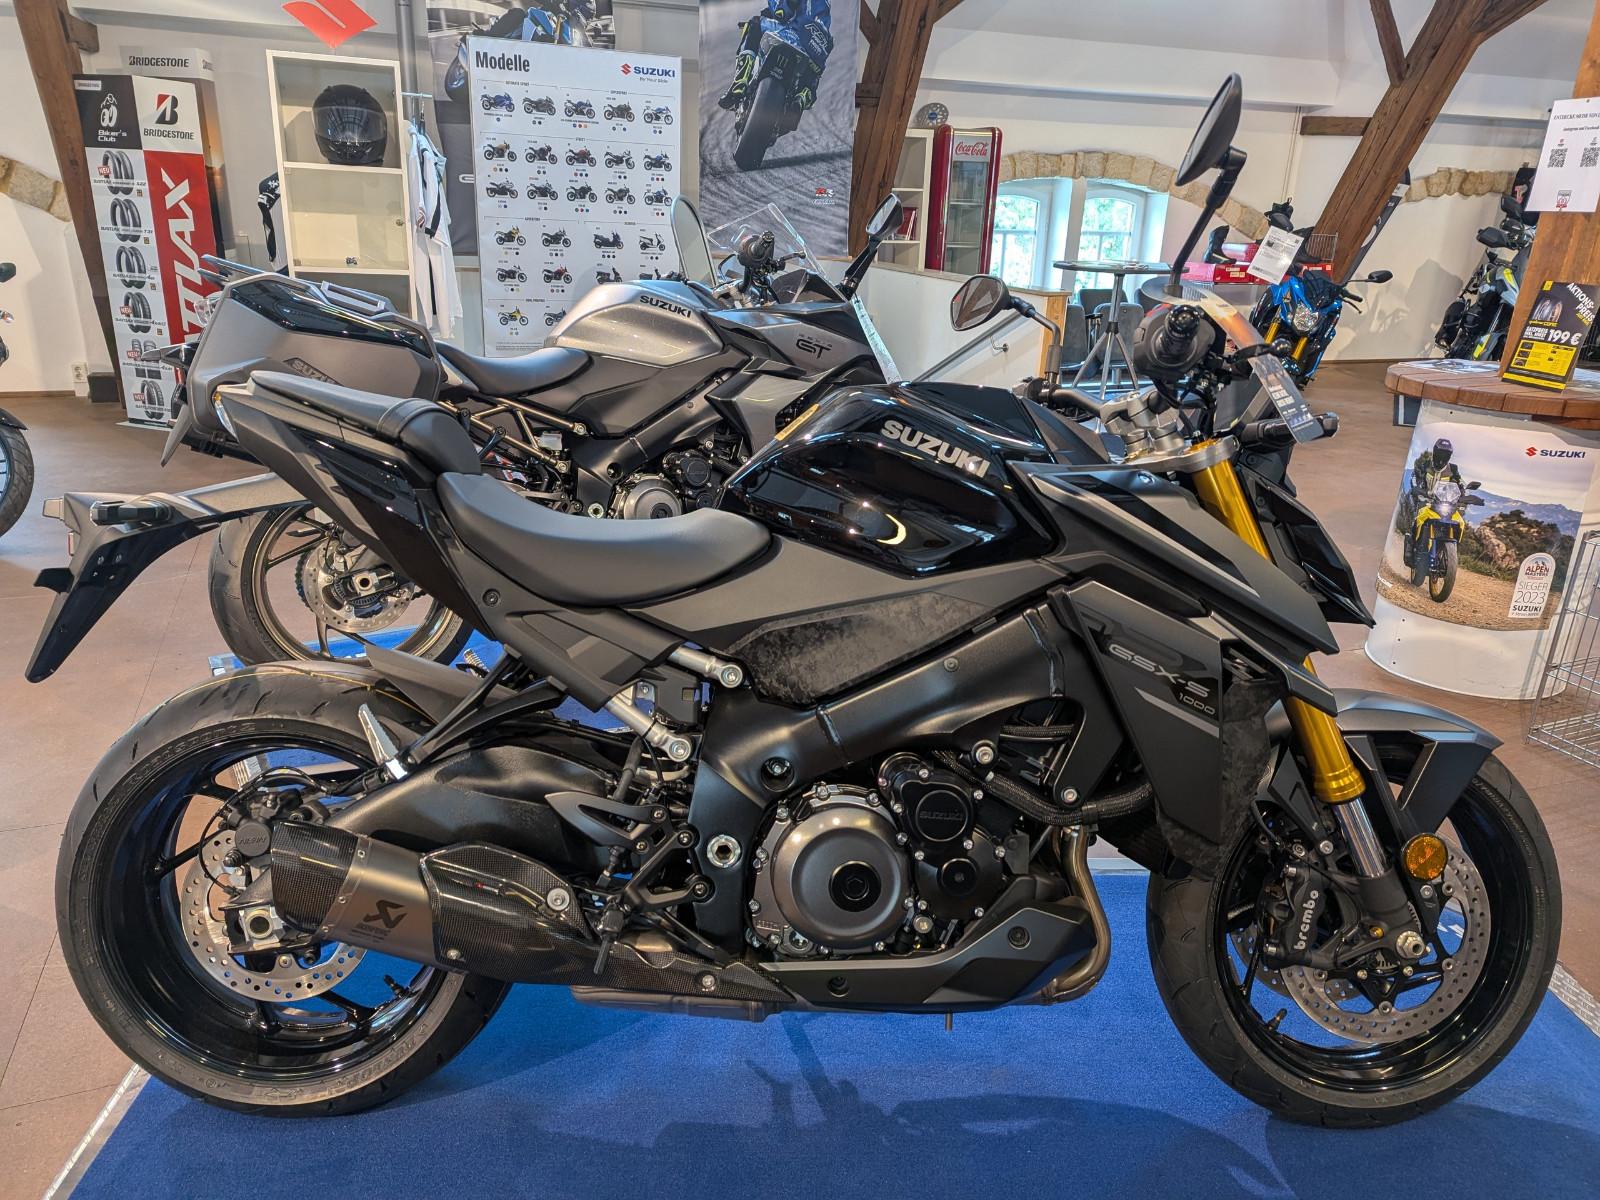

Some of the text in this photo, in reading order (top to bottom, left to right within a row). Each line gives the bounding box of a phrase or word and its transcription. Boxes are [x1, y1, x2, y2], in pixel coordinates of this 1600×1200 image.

[128, 55, 190, 68] BRIDGESTONE
[475, 50, 530, 73] Modelle
[633, 66, 676, 78] SUZUKI
[98, 129, 128, 137] Biker's
[143, 127, 195, 140] BRIDGESTONE
[1566, 282, 1595, 309] AKTIONS-
[639, 295, 692, 319] SUZUKI
[1575, 302, 1595, 322] PREIS
[1547, 328, 1583, 346] 199 €
[795, 338, 832, 360] GT
[880, 419, 991, 478] SUZUKI
[1539, 449, 1586, 459] SUZUKI
[1525, 565, 1550, 573] ALPEN
[1517, 580, 1549, 591] SIEGER
[1514, 590, 1546, 605] 2023
[1512, 604, 1542, 612] SUZUKI
[1108, 643, 1211, 698] GSX-S
[1179, 692, 1216, 716] 1000
[919, 810, 964, 822] SUZUKI
[1293, 889, 1319, 950] brembo
